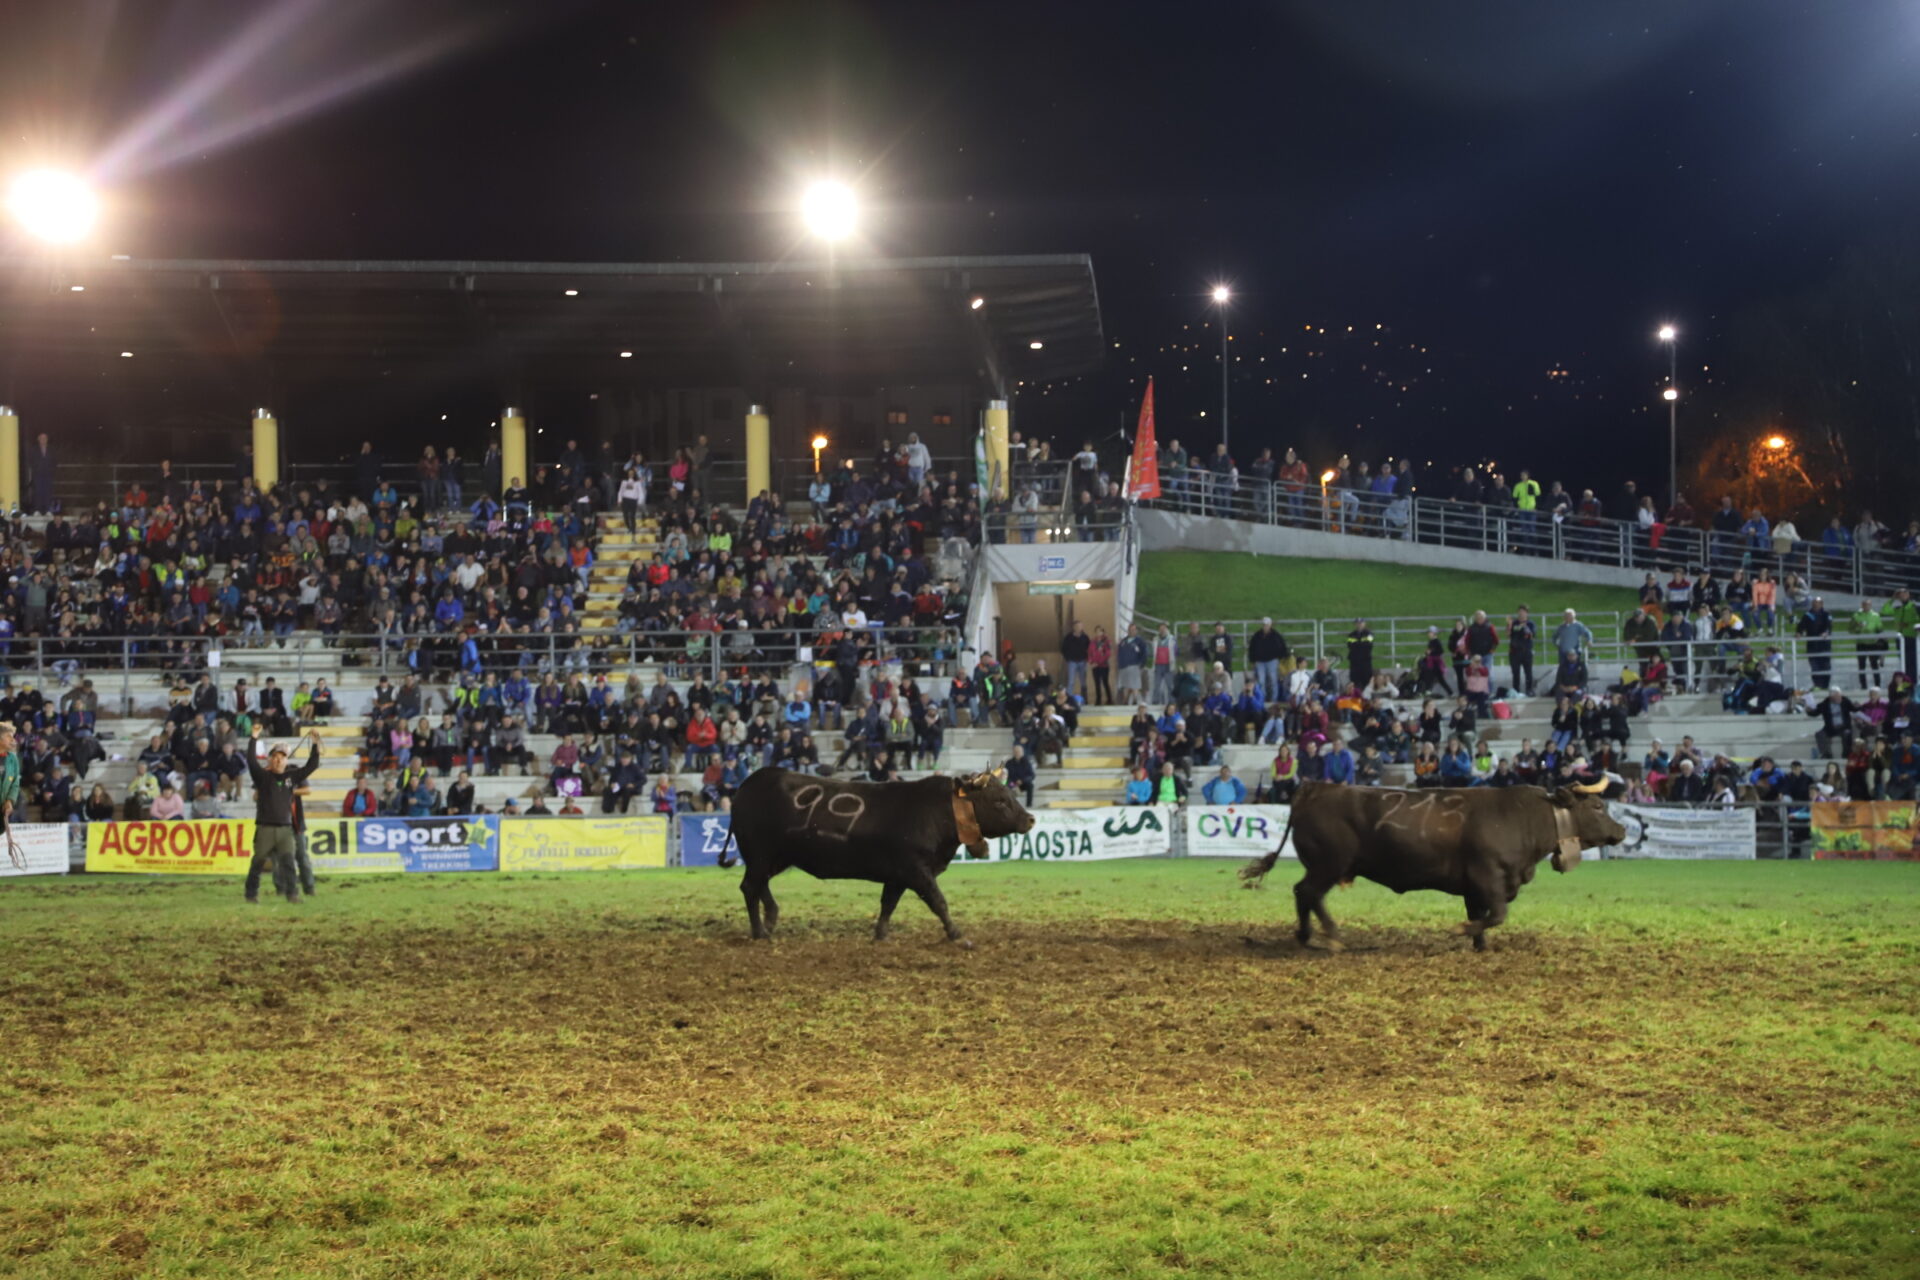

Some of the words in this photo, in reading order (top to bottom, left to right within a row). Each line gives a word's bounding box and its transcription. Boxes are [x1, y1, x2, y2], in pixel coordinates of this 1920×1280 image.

[787, 784, 865, 841] 99
[1198, 813, 1268, 840] CVR
[1375, 791, 1465, 837] 213
[98, 821, 250, 857] AGROVAL
[305, 821, 348, 855] al
[363, 822, 461, 850] Sport
[1000, 830, 1093, 860] D'AOSTA
